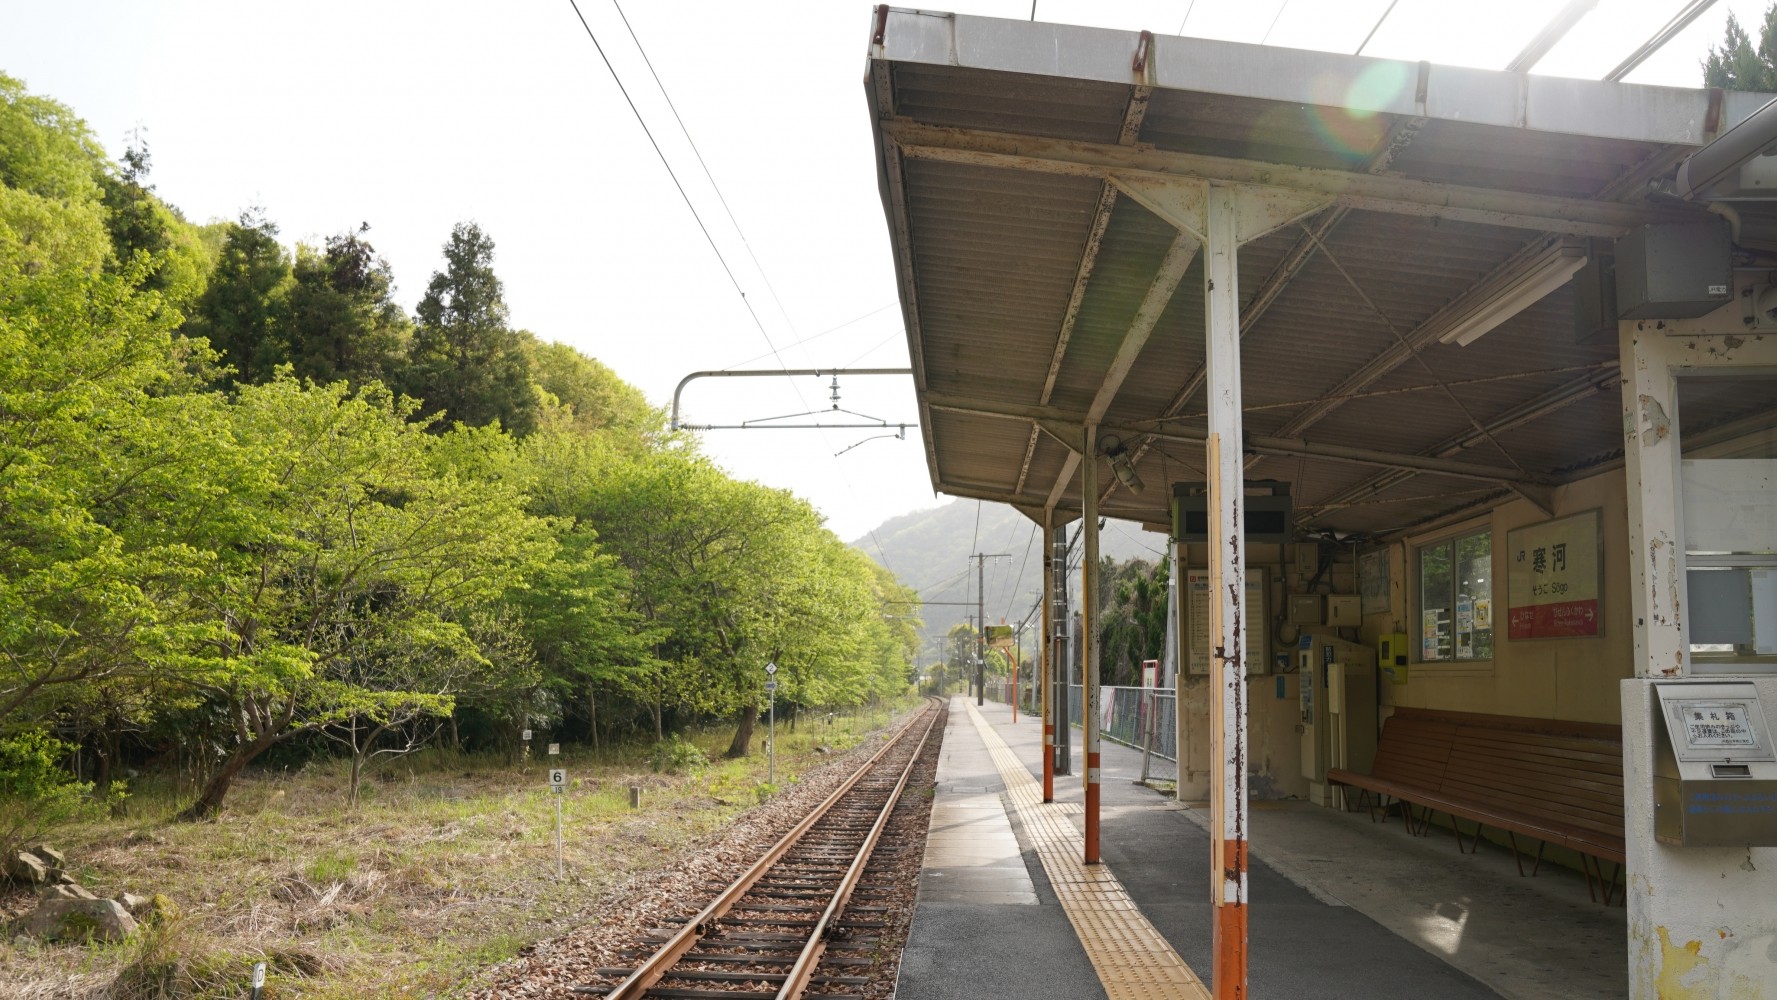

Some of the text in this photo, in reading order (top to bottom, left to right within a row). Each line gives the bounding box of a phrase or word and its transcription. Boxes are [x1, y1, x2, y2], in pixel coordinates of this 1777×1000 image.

[1517, 543, 1567, 574] JR 寒河
[553, 772, 562, 783] 6
